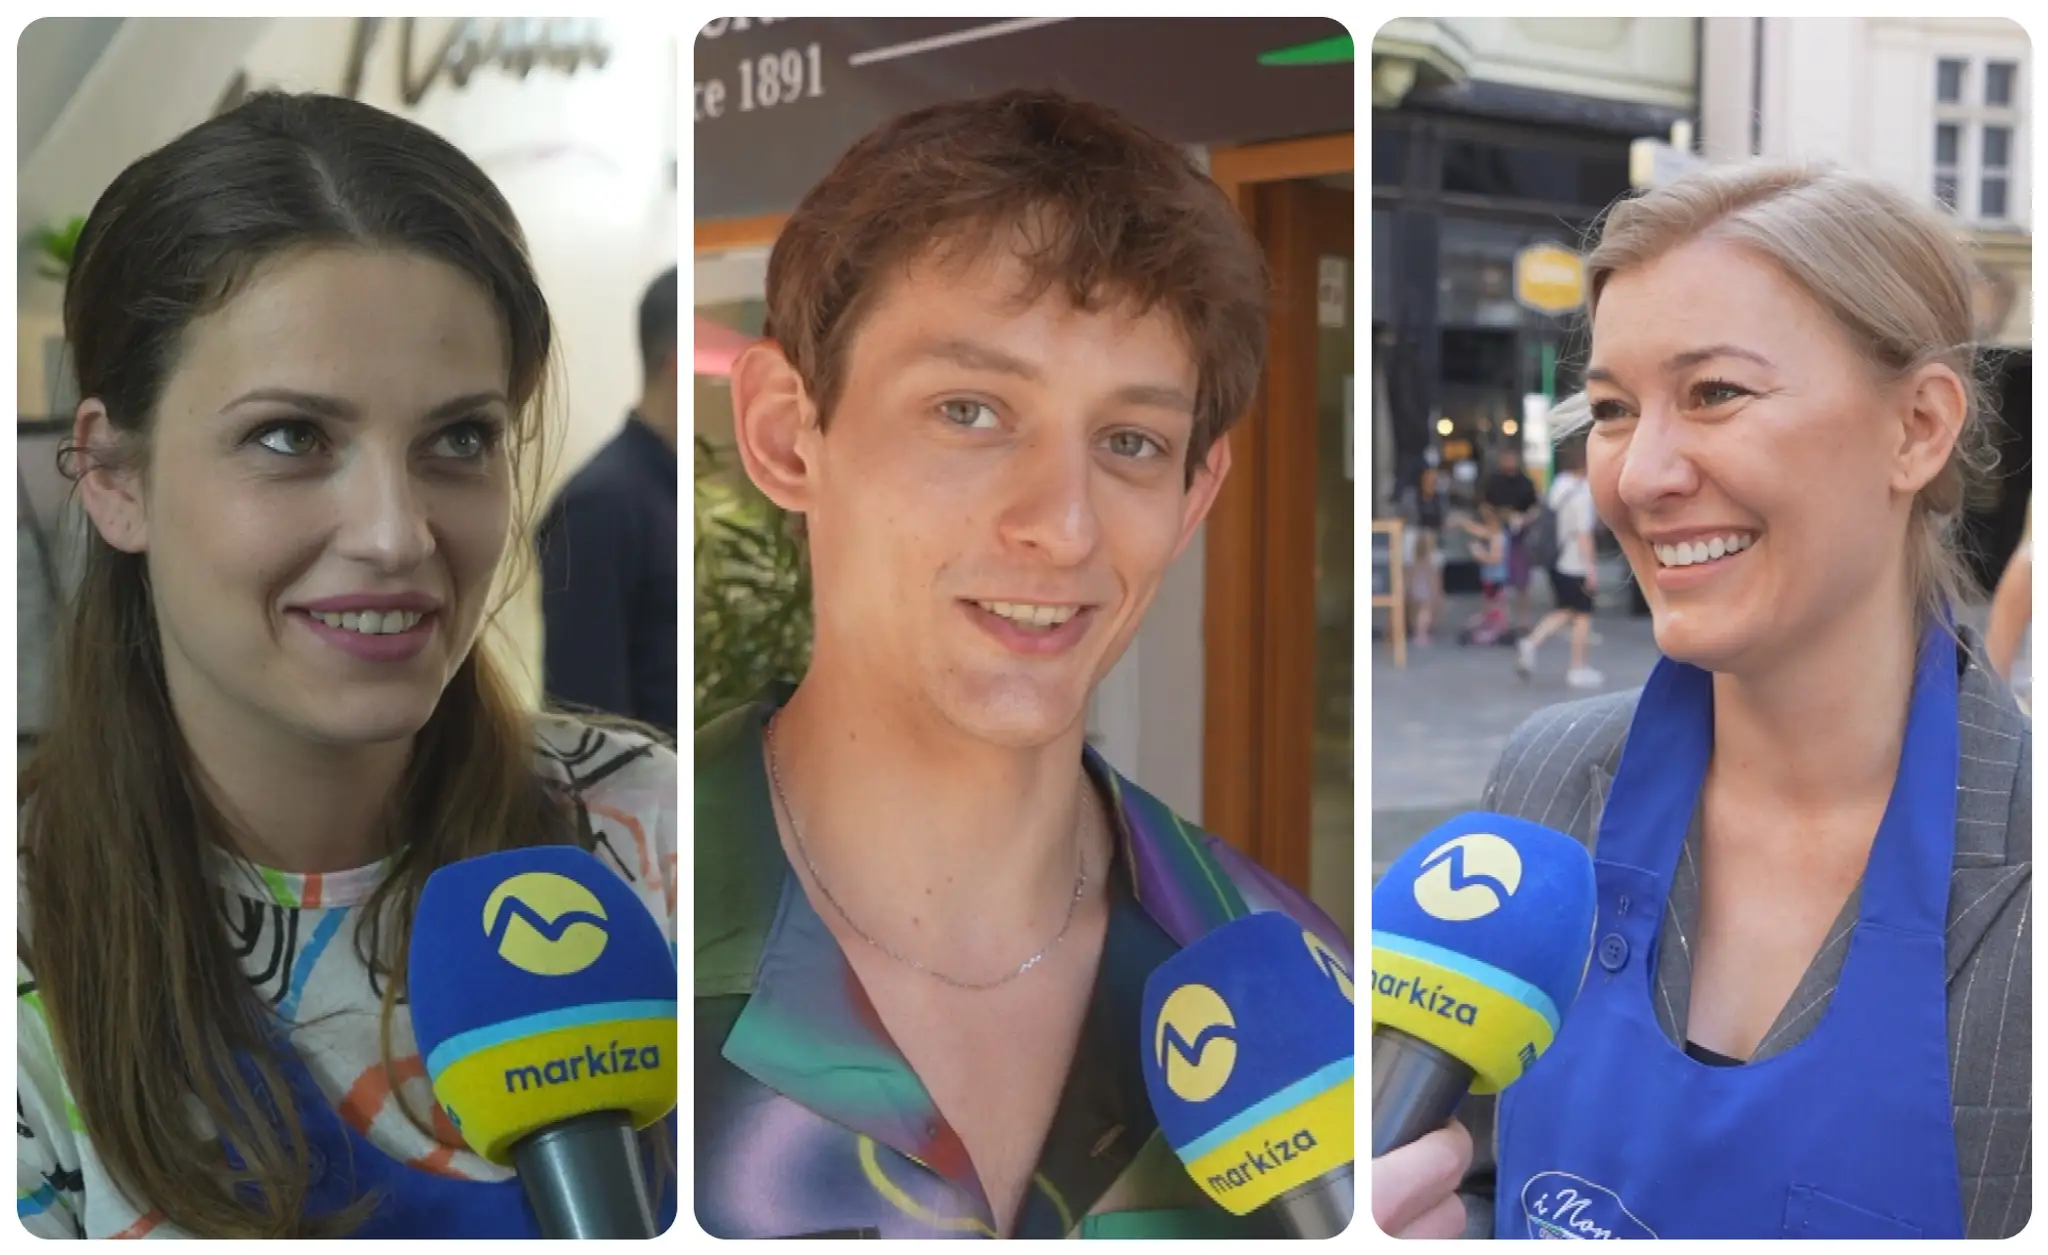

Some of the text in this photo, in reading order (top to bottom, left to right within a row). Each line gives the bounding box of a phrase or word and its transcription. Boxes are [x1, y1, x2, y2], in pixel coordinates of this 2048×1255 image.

[738, 42, 825, 112] 1891
[505, 1040, 660, 1093] markíza
[1206, 1129, 1318, 1195] markíza
[1552, 1188, 1622, 1239] Non
